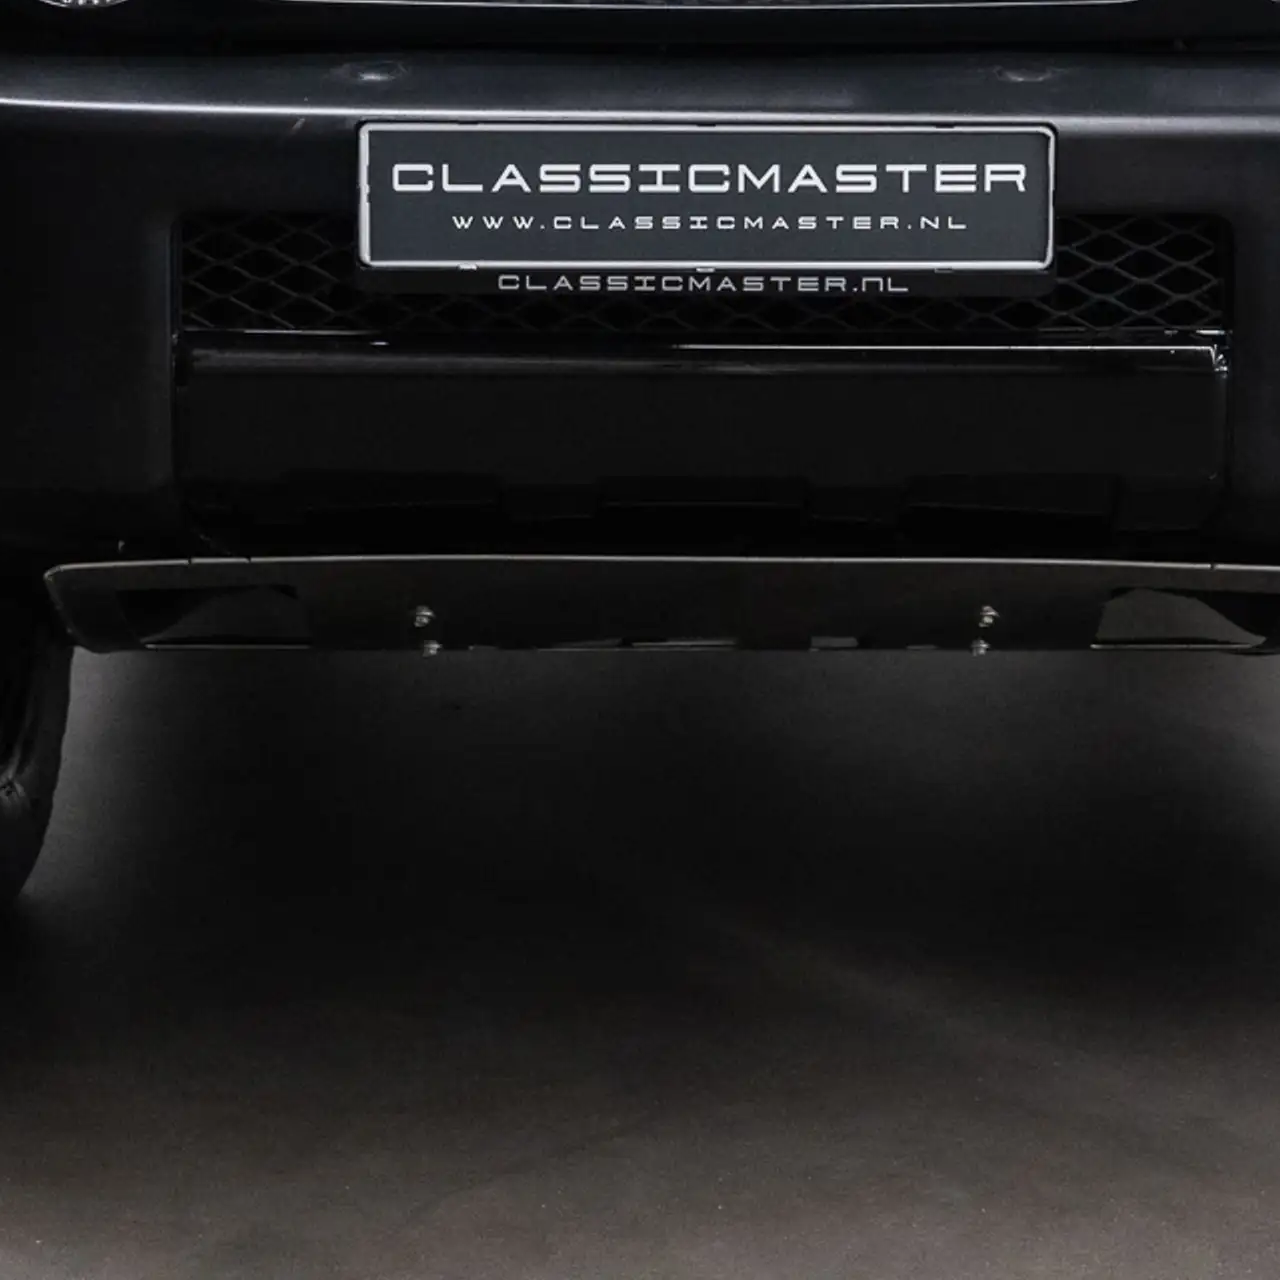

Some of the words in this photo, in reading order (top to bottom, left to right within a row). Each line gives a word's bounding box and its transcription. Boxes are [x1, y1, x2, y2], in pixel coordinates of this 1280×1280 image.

[391, 162, 1028, 194] CLASSICMASTER
[450, 214, 968, 231] WWW.CLASSICMASTER.NL
[496, 273, 910, 294] CLASSICMASTER.NL
